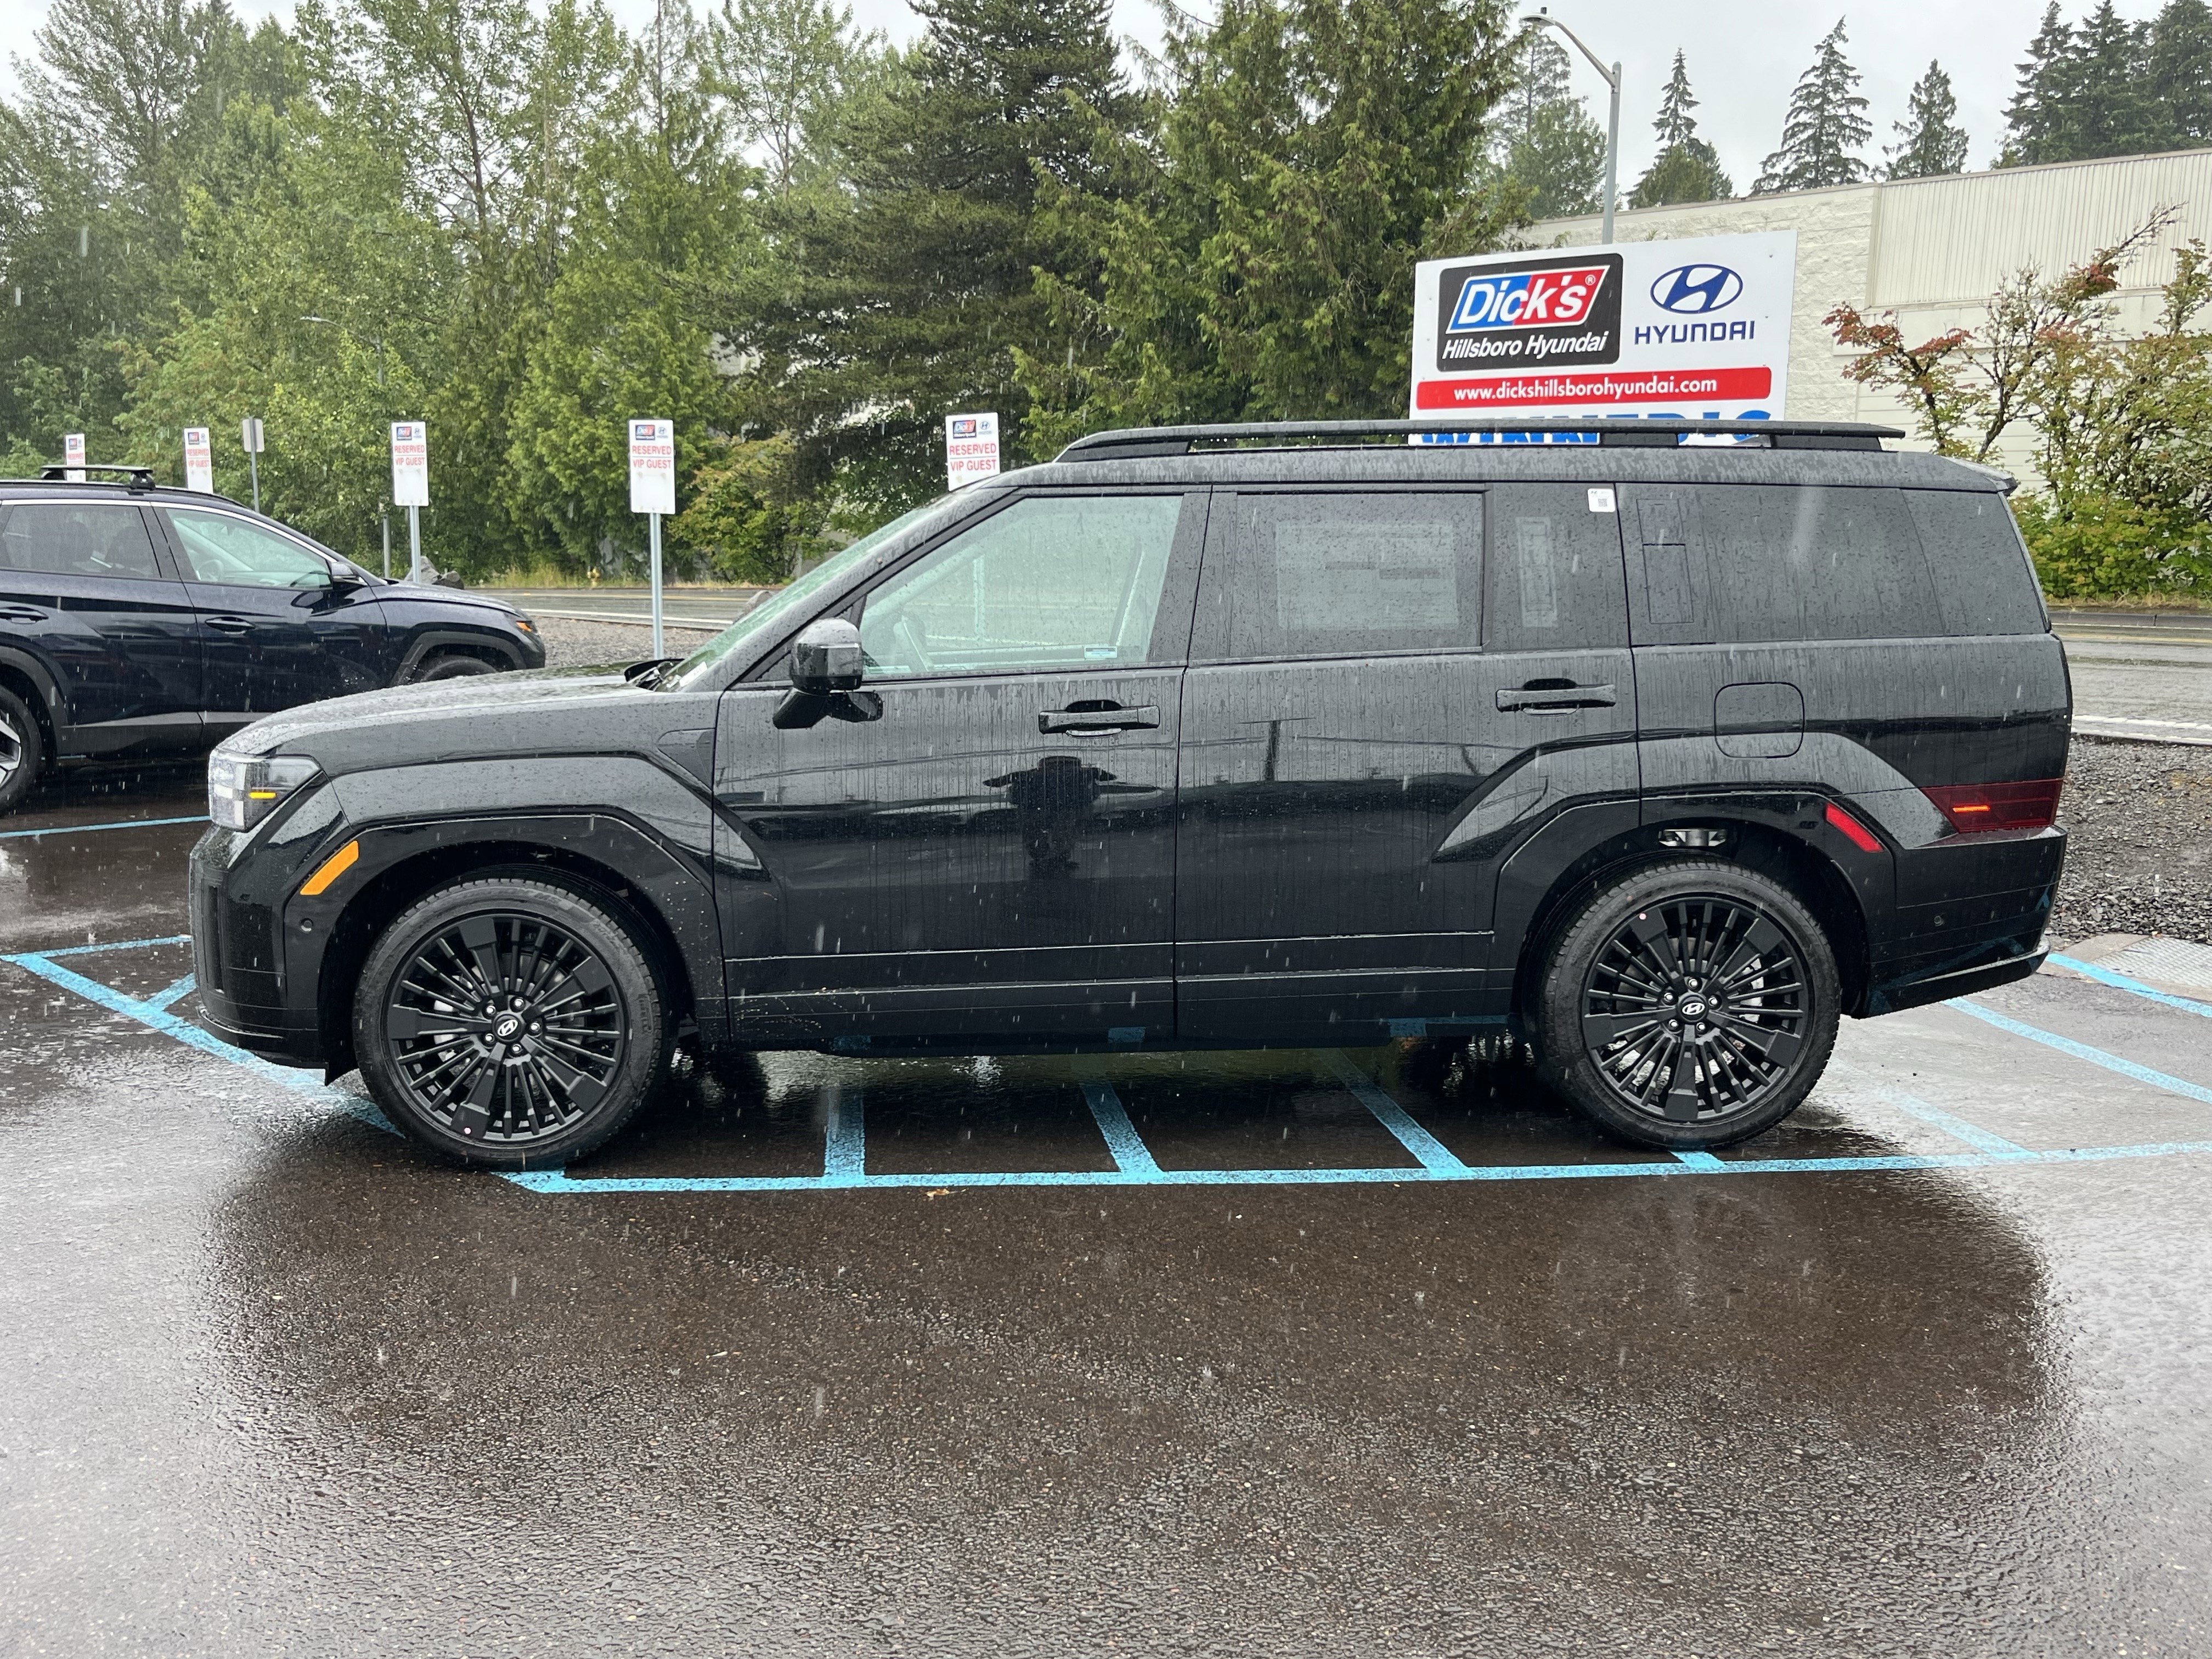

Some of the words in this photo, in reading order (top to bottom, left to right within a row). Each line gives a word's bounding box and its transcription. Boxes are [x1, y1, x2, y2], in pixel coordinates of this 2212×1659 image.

[1457, 275, 1588, 325] Dick's
[1634, 320, 1755, 345] HYUNDAI
[1441, 337, 1523, 360] Hillsboro
[1525, 330, 1610, 360] Hyundai
[1454, 376, 1717, 400] www.dickshillsborohyundai.com
[394, 444, 425, 454] RESERVED
[632, 445, 672, 455] RESERVED
[949, 443, 997, 456] RESERVED
[395, 457, 404, 466] VIP
[405, 456, 425, 466] GUEST
[633, 459, 645, 469] VIP
[646, 459, 672, 469] GUEST
[950, 461, 964, 471] VIP
[967, 459, 997, 471] GUEST
